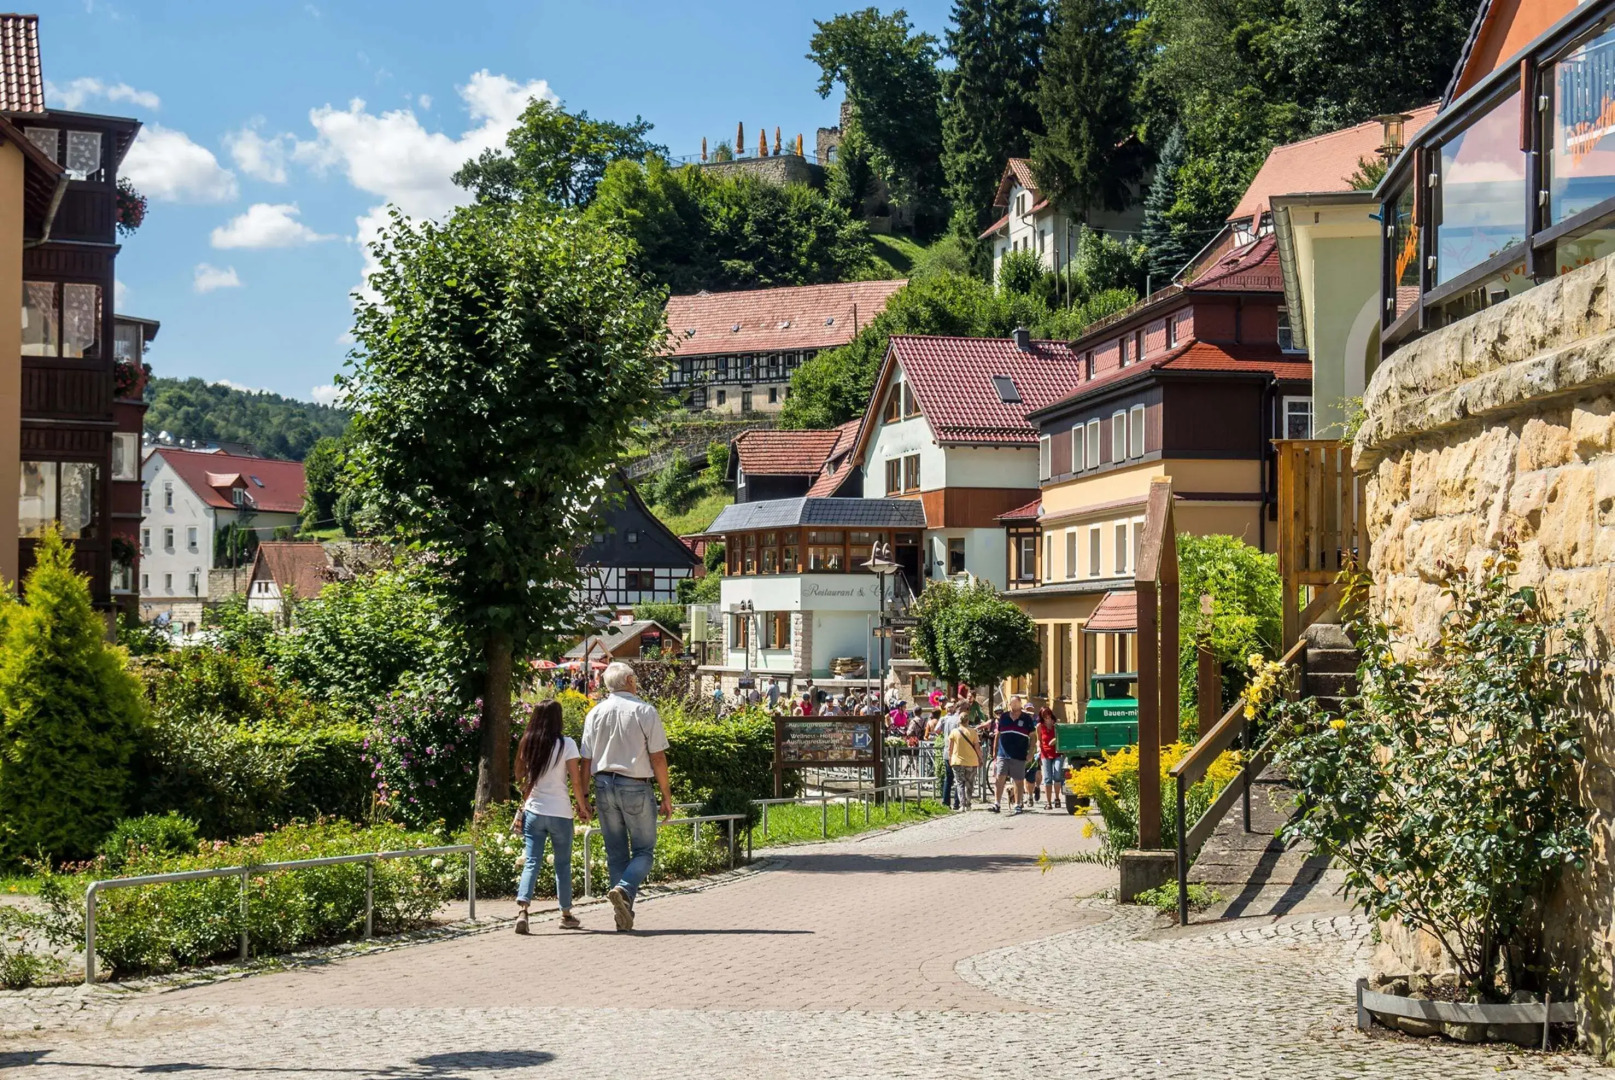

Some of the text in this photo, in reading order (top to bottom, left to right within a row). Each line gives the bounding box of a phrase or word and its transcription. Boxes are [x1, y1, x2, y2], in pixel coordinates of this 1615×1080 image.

[803, 583, 893, 598] Restaurant & Cfe
